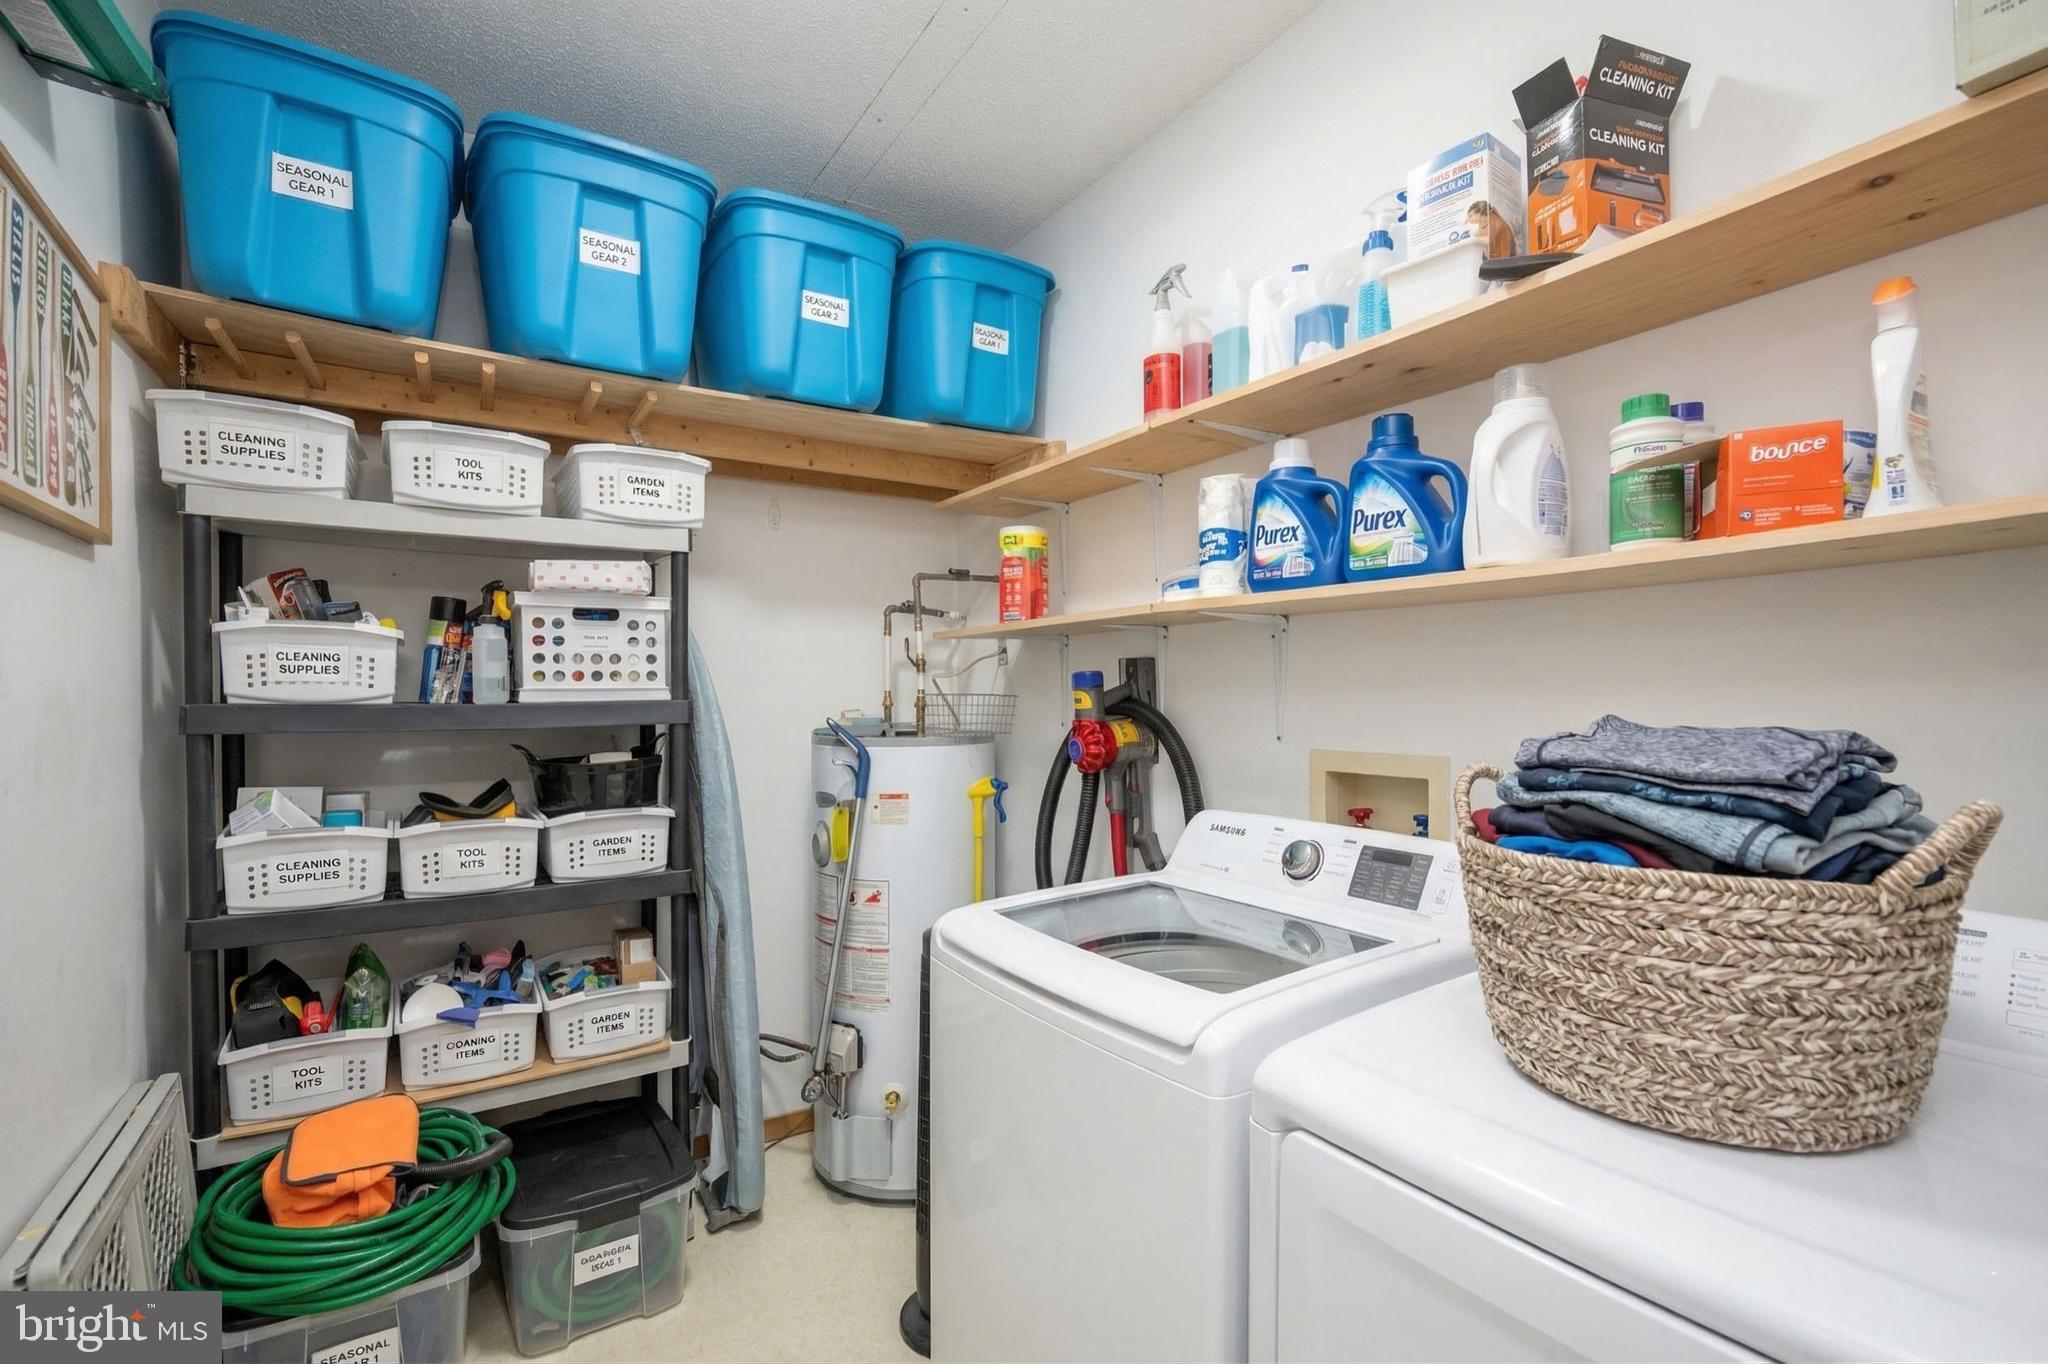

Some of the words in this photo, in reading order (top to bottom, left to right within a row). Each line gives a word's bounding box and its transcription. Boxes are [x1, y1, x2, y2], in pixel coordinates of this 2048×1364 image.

[1600, 67, 1655, 95] CLEANING
[1656, 83, 1675, 100] KIT
[1589, 127, 1646, 151] CLEANING
[1648, 141, 1665, 156] KIT
[276, 161, 349, 188] SEASONAL
[288, 179, 325, 197] GEAR
[330, 189, 334, 199] 1
[582, 235, 635, 256] SEASONAL
[591, 250, 619, 265] GEAR
[621, 257, 627, 267] 2
[804, 295, 845, 311] SEASONAL
[811, 307, 832, 319] GEAR
[833, 312, 839, 321] 2
[217, 431, 286, 448] CLEANING
[220, 444, 286, 461] SUPPLIES
[1750, 437, 1827, 463] bounce
[455, 457, 484, 469] TOOL
[458, 470, 483, 481] KITS
[632, 487, 660, 498] ITEMS
[1352, 508, 1407, 535] Purex
[1256, 524, 1300, 547] Purex
[275, 651, 341, 662] CLEANING
[279, 664, 340, 675] SUPPLIES
[1209, 823, 1247, 837] SAMSUNG
[592, 836, 632, 847] GARDEN
[456, 847, 487, 858] TOOL
[598, 847, 626, 857] ITEMS
[276, 858, 341, 872] CLEANING
[460, 859, 485, 869] KITS
[279, 870, 341, 884] SUPPLIES
[596, 1022, 624, 1034] ITEMS
[455, 1047, 485, 1060] ITEMS
[290, 1066, 325, 1078] TOOL
[295, 1077, 322, 1090] KITS
[320, 1339, 391, 1364] SEASONAL
